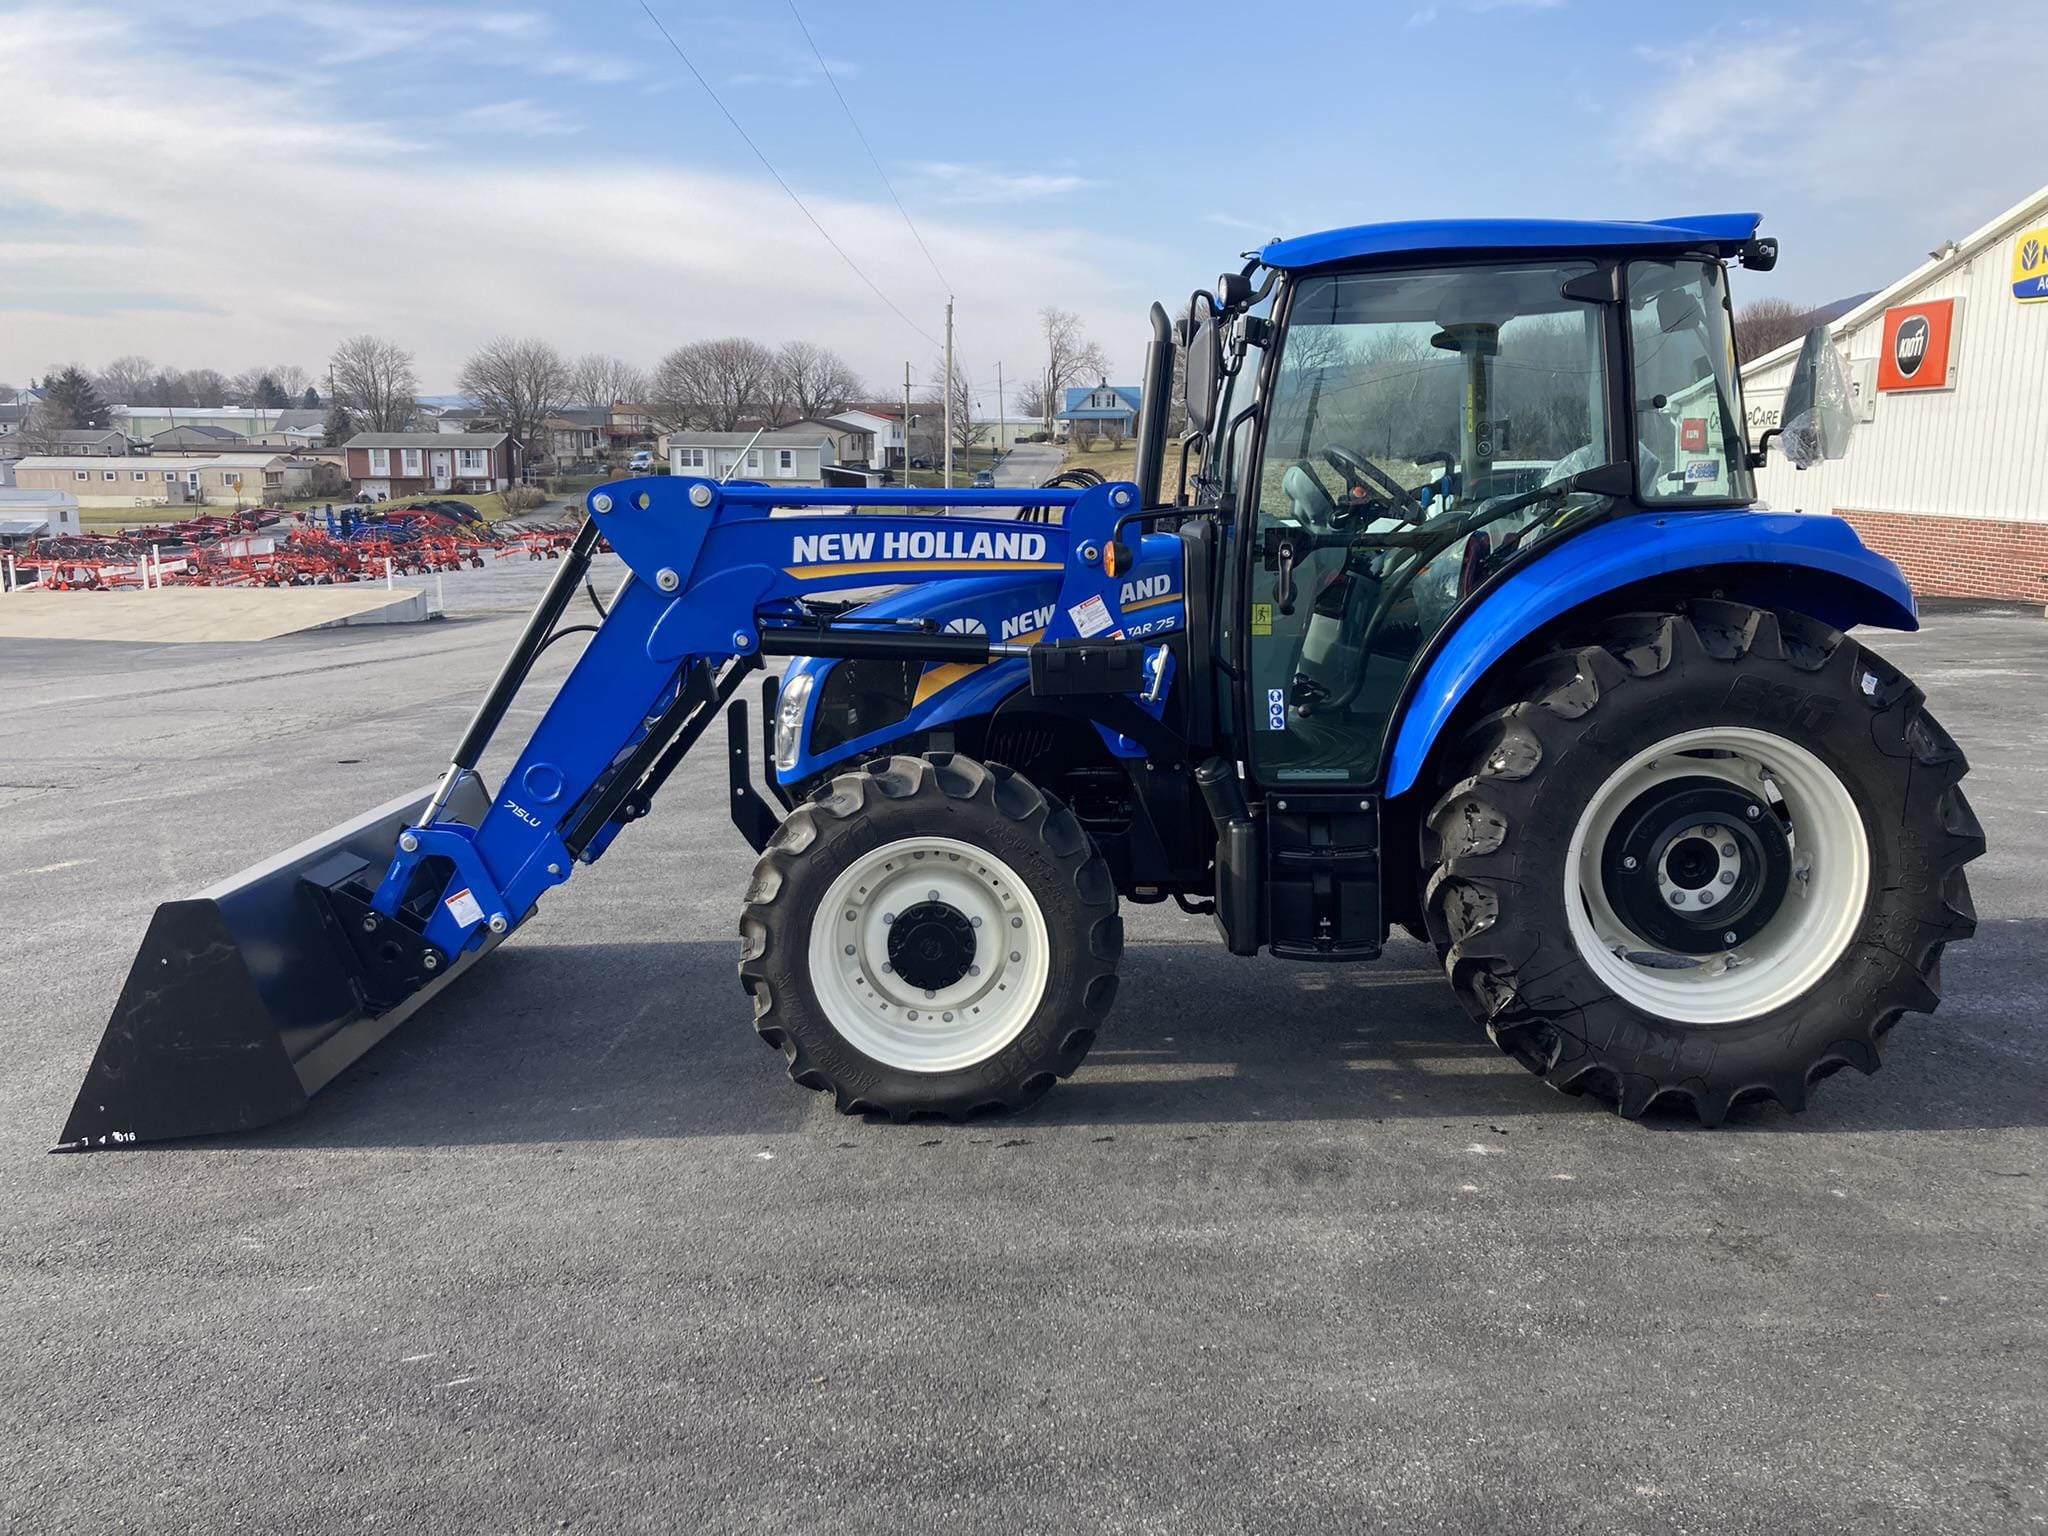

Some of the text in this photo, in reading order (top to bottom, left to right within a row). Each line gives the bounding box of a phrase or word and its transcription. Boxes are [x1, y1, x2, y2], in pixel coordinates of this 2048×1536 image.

[1898, 324, 1926, 358] KIOTI
[792, 530, 1047, 563] NEW HOLLAND
[1001, 604, 1056, 640] NEW
[1156, 616, 1176, 631] 75
[503, 799, 542, 827] 715LU
